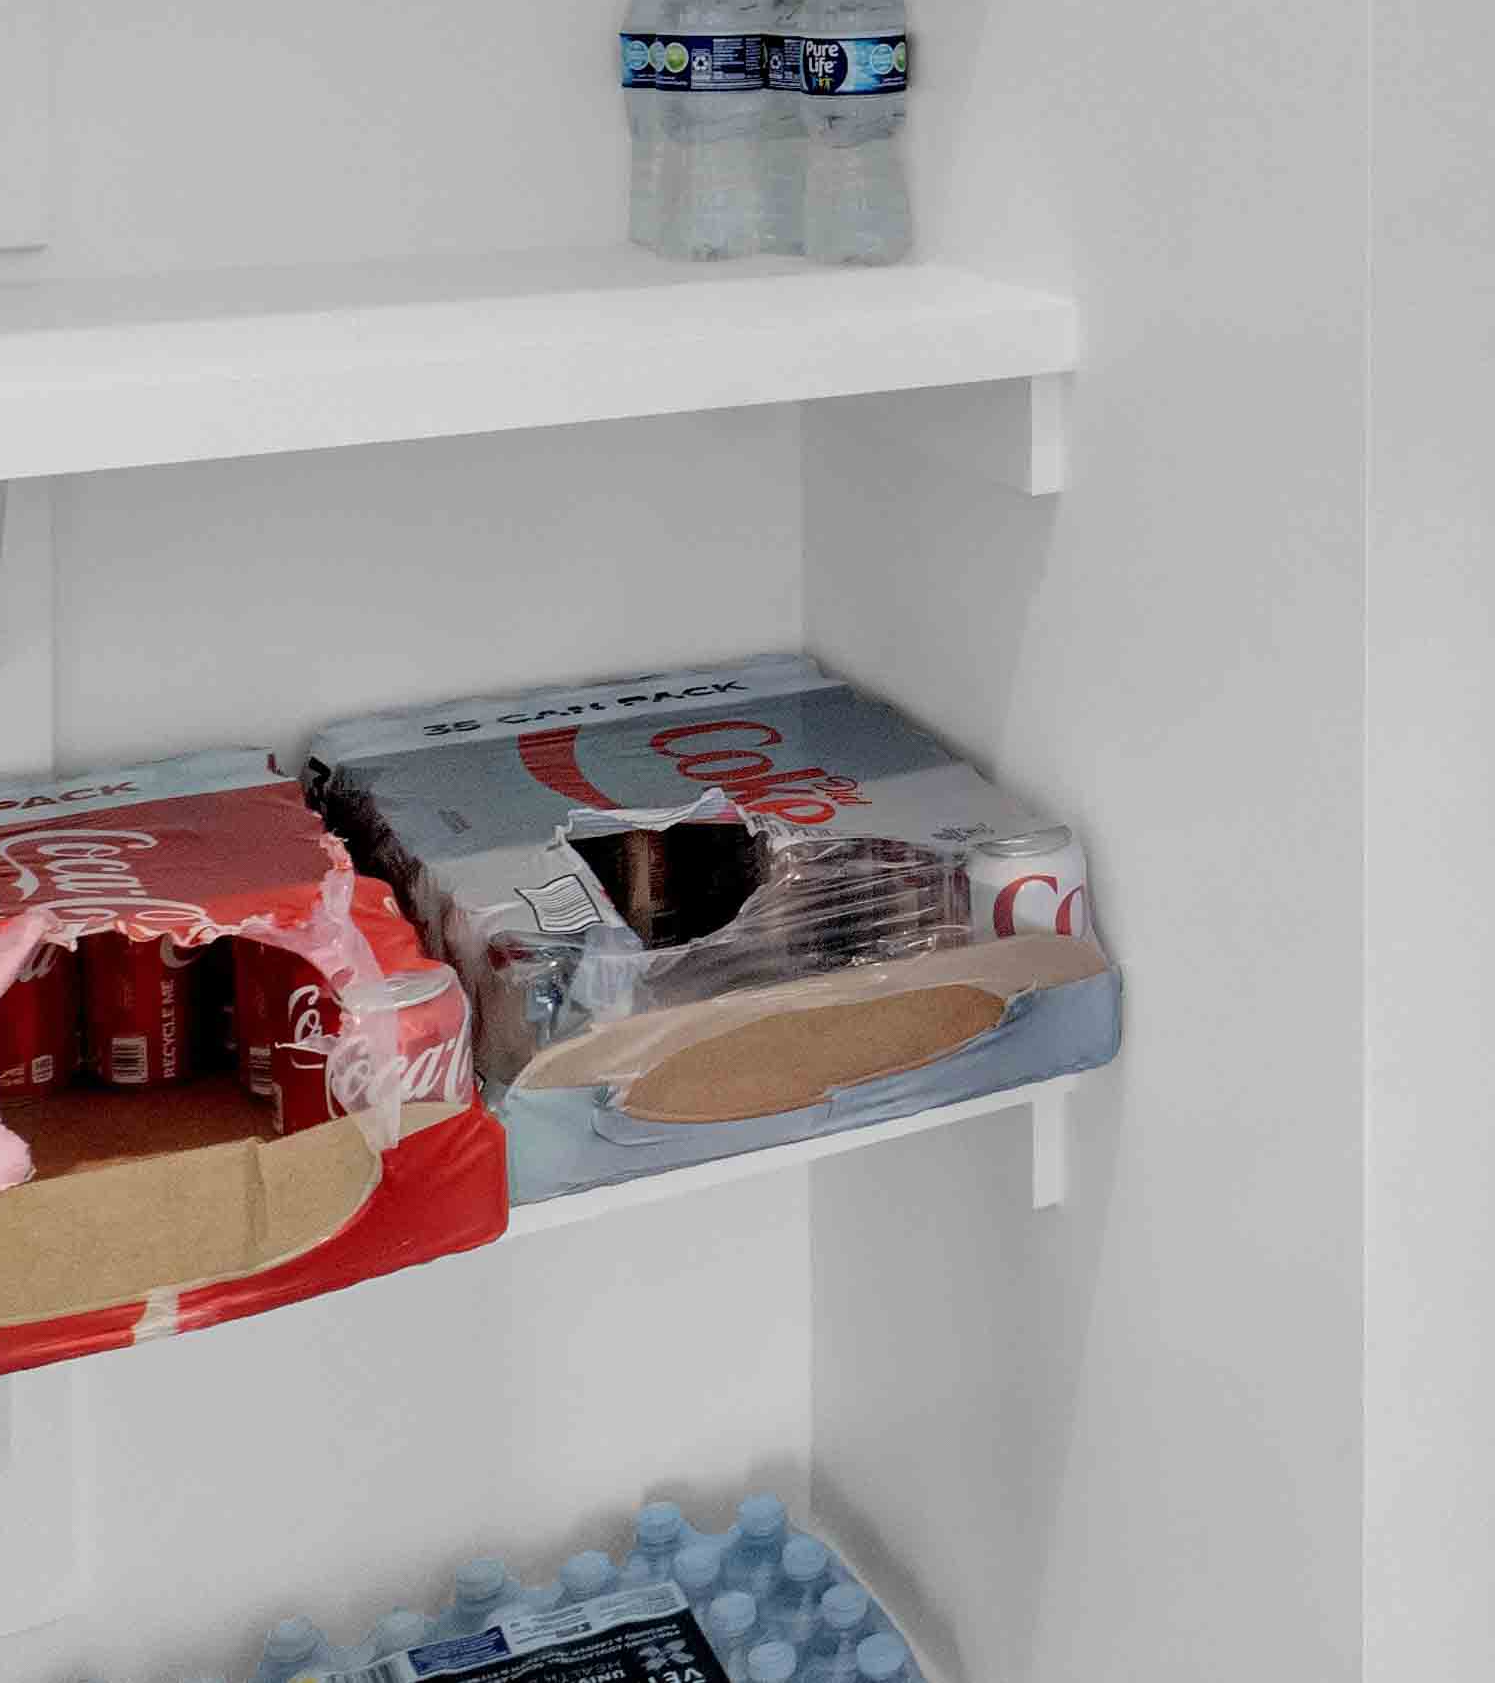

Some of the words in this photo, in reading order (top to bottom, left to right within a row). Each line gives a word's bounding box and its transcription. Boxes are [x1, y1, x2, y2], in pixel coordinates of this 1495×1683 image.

[805, 40, 839, 60] Pure
[422, 718, 481, 737] 35
[617, 679, 750, 708] PACK
[161, 979, 176, 1008] ME
[161, 1008, 177, 1080] RECYCLE
